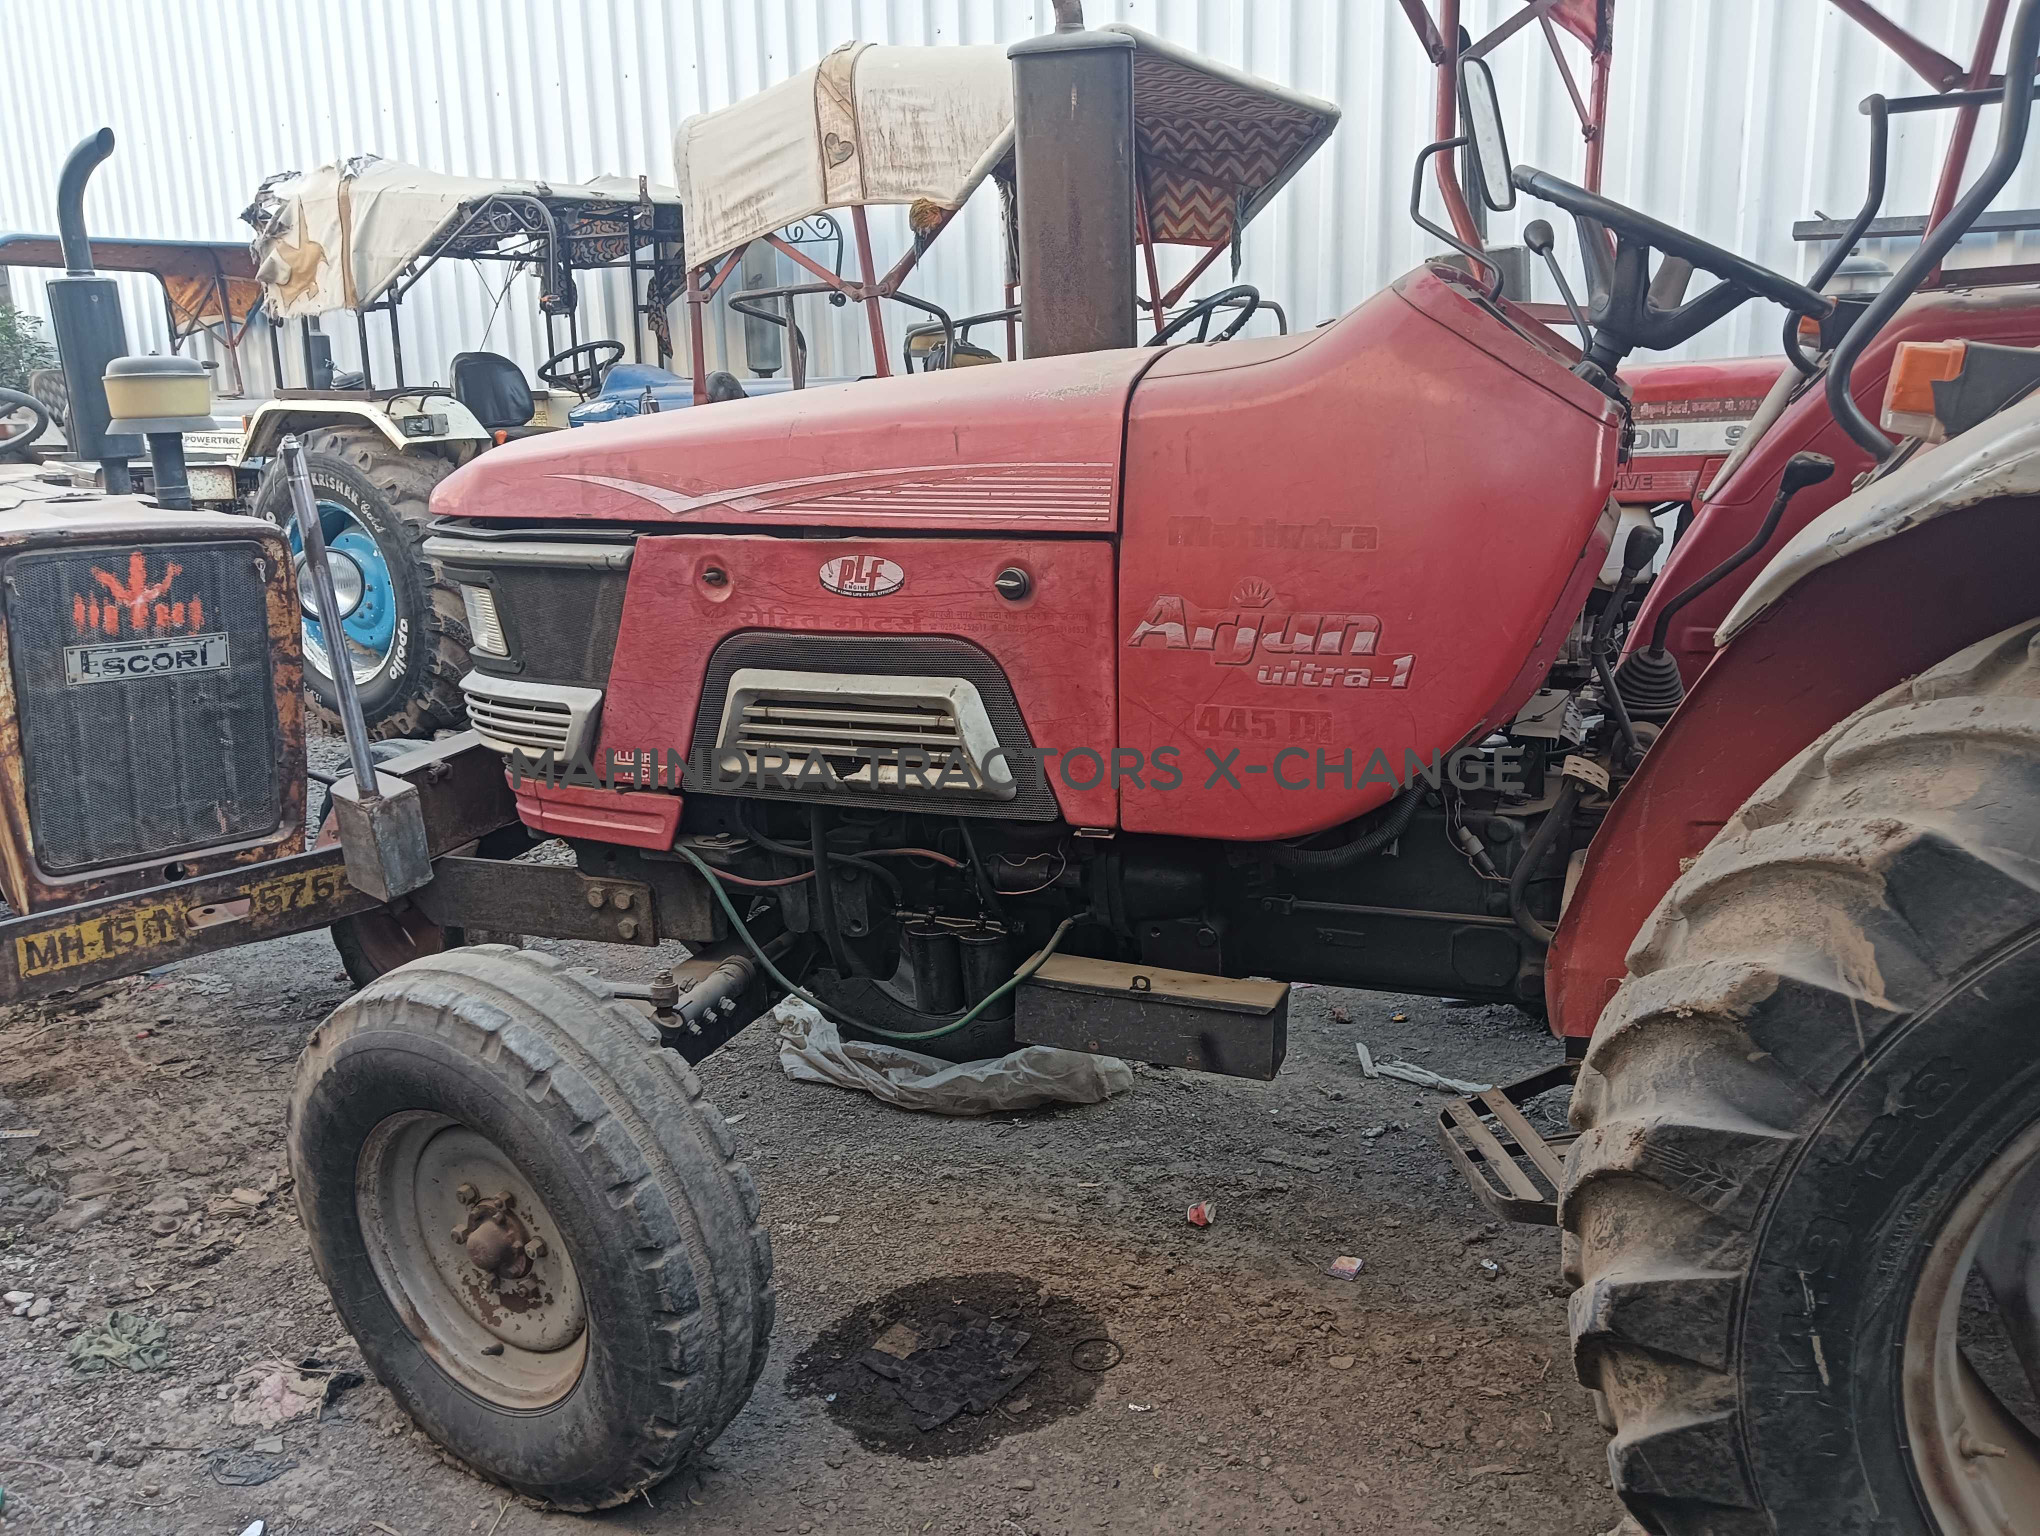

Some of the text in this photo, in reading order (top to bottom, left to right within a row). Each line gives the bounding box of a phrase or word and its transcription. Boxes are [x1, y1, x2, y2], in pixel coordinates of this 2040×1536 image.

[310, 472, 359, 506] KRISHAK
[1130, 594, 1382, 666] Arjun
[389, 618, 408, 680] apollo
[1257, 653, 1416, 689] ultra-1
[1197, 705, 1277, 740] 445
